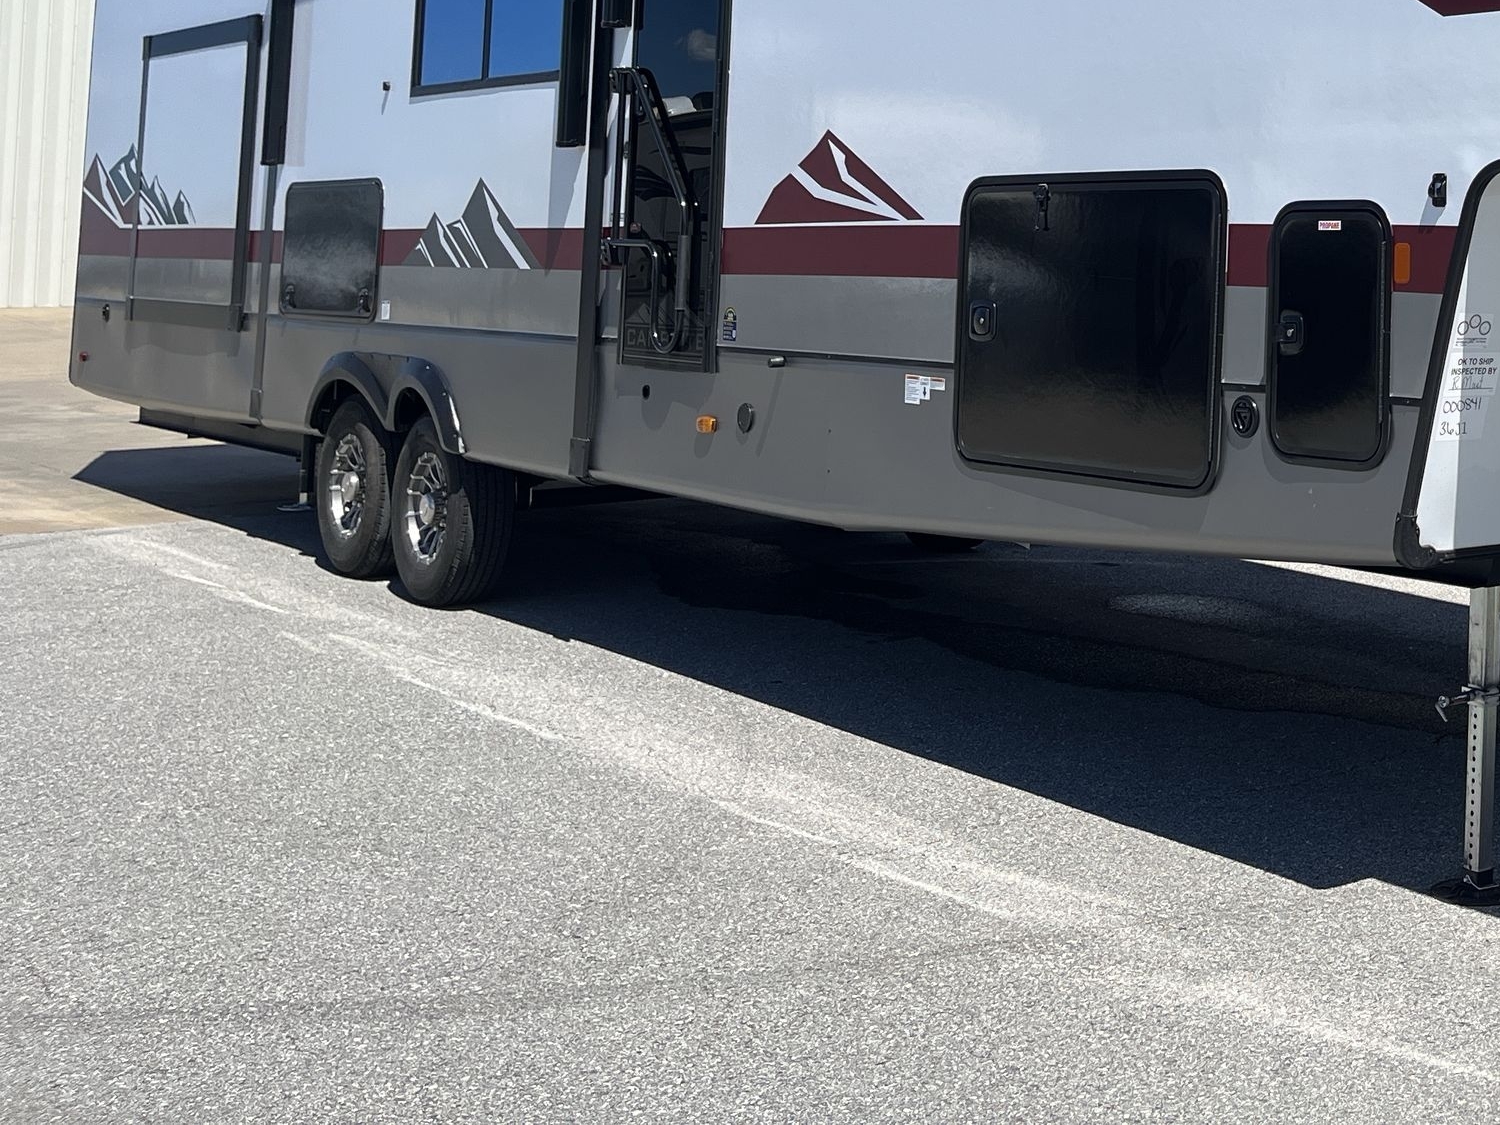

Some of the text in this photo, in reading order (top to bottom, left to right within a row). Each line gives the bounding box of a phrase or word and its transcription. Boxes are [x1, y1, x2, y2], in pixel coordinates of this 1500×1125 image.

[1458, 357, 1495, 366] OK TO SHIP
[1451, 367, 1498, 376] INSPECTED BY
